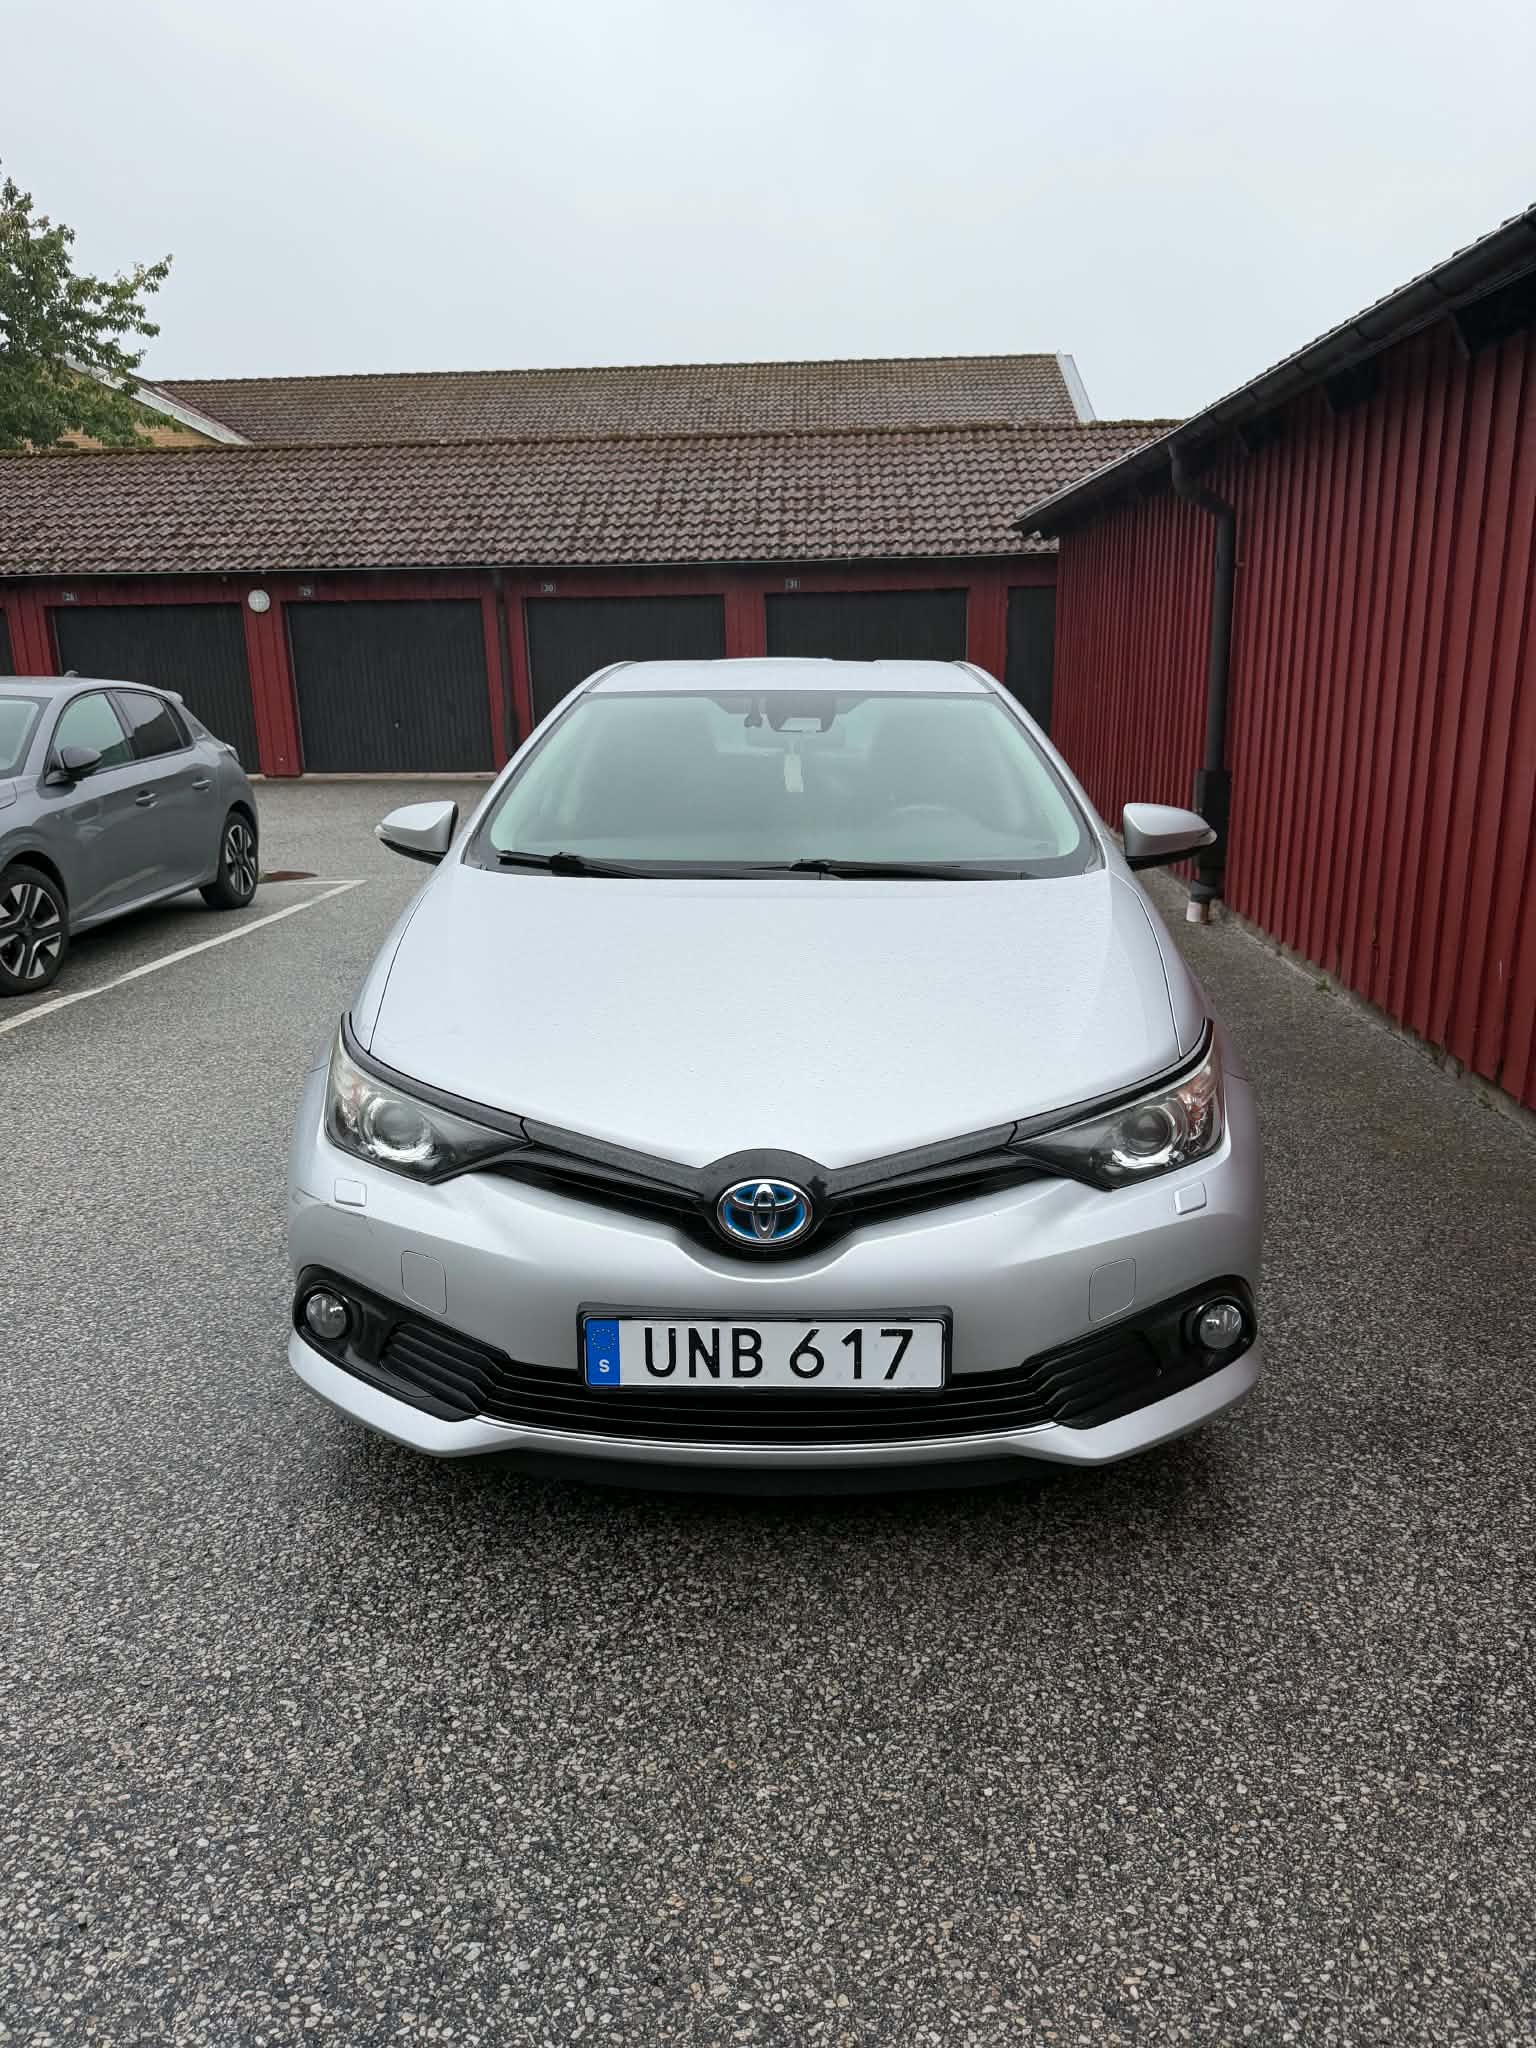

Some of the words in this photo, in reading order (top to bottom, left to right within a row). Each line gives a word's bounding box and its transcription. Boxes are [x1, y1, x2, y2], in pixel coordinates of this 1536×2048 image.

[598, 1359, 610, 1373] S
[644, 1327, 763, 1378] UNB
[789, 1328, 914, 1380] 617
